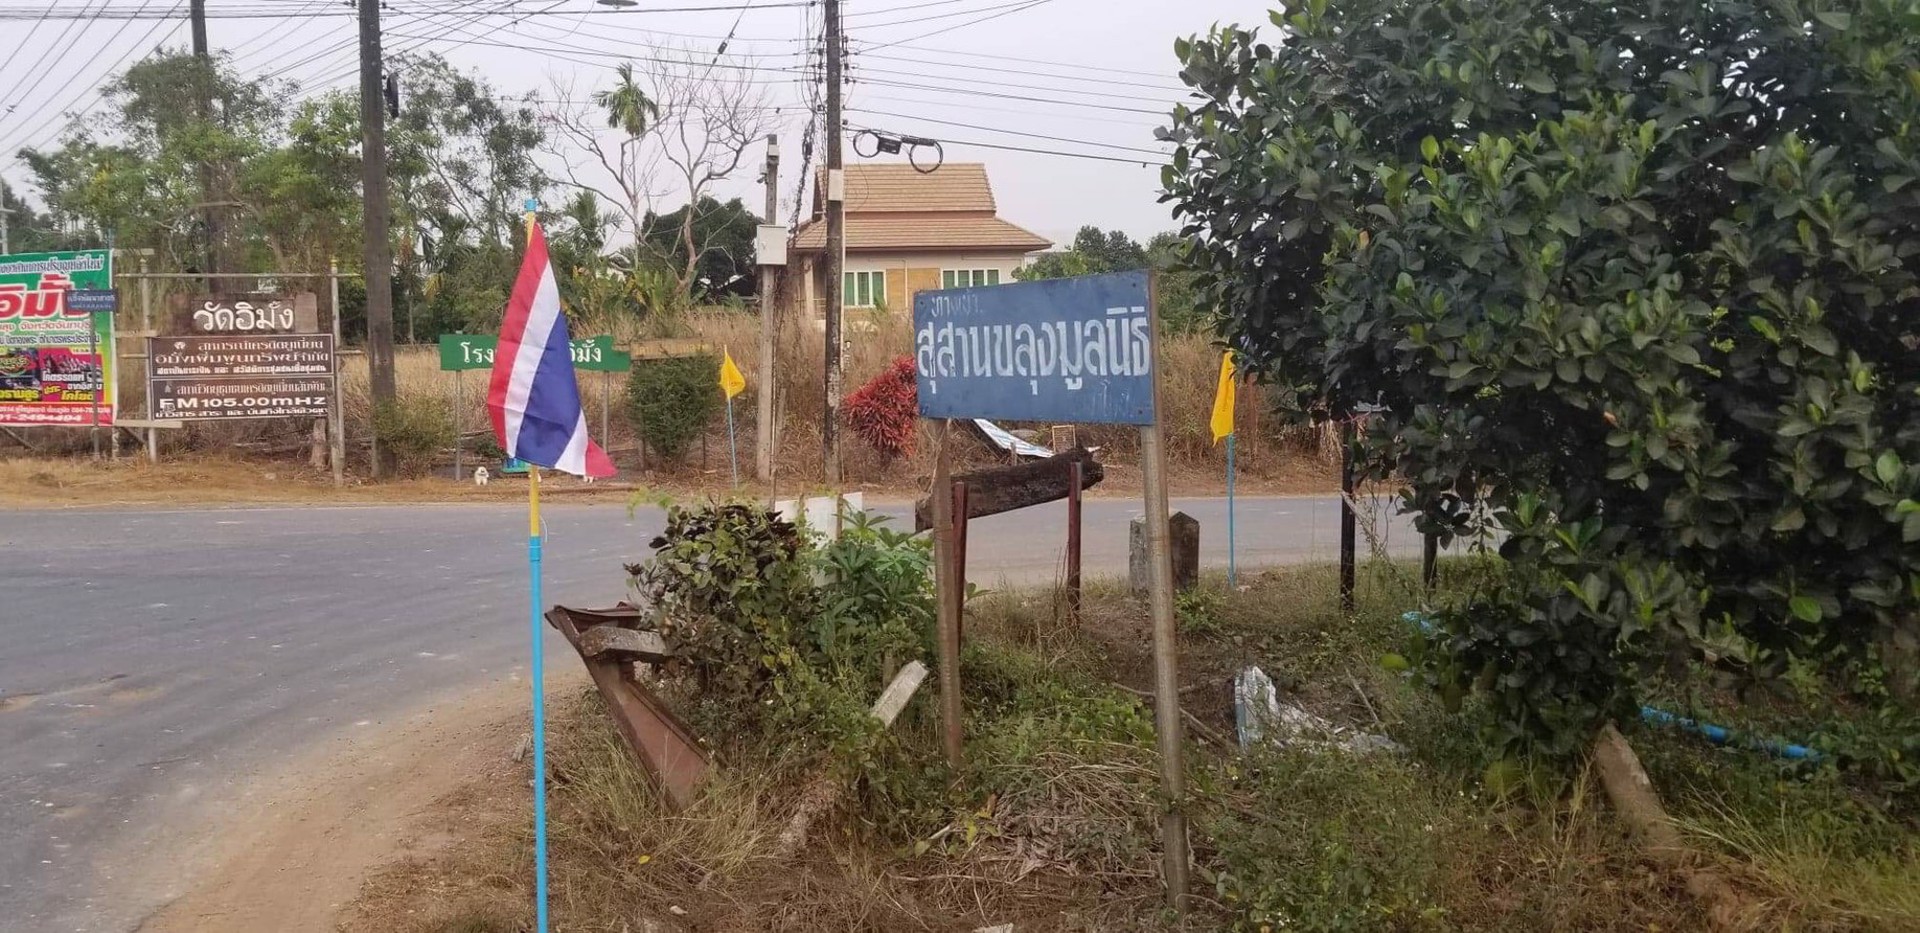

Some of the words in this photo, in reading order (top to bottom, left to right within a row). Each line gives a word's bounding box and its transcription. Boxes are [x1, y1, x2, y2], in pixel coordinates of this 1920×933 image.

[193, 301, 294, 331] วัดอิมั้ง
[917, 306, 1151, 396] สุสานขลุงมูลนิธิ
